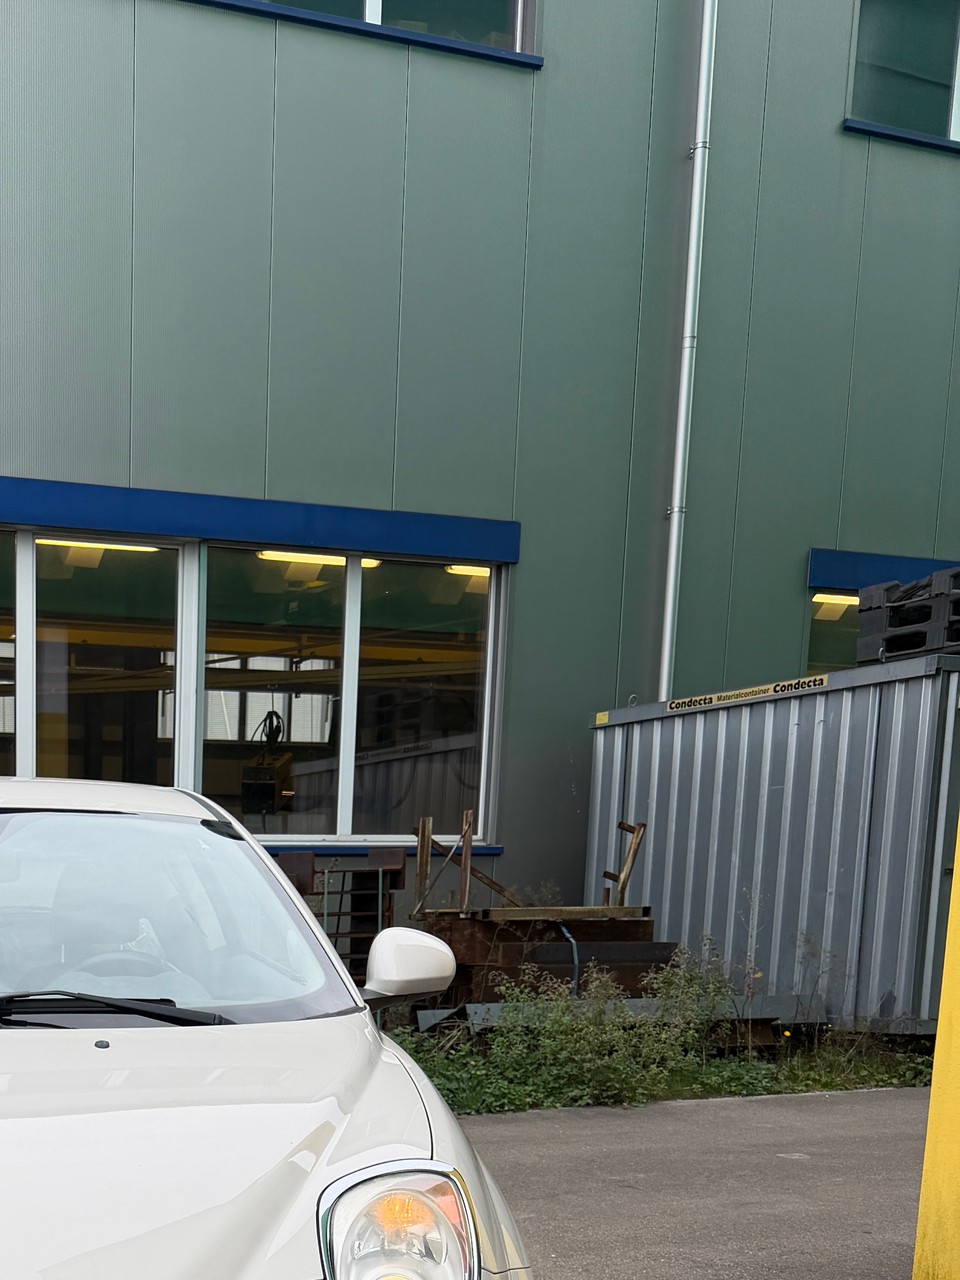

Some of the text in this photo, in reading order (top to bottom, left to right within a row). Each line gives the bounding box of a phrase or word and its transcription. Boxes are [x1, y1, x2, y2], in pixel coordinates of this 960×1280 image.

[669, 676, 824, 711] Condecta Materialcontainer Condecta
